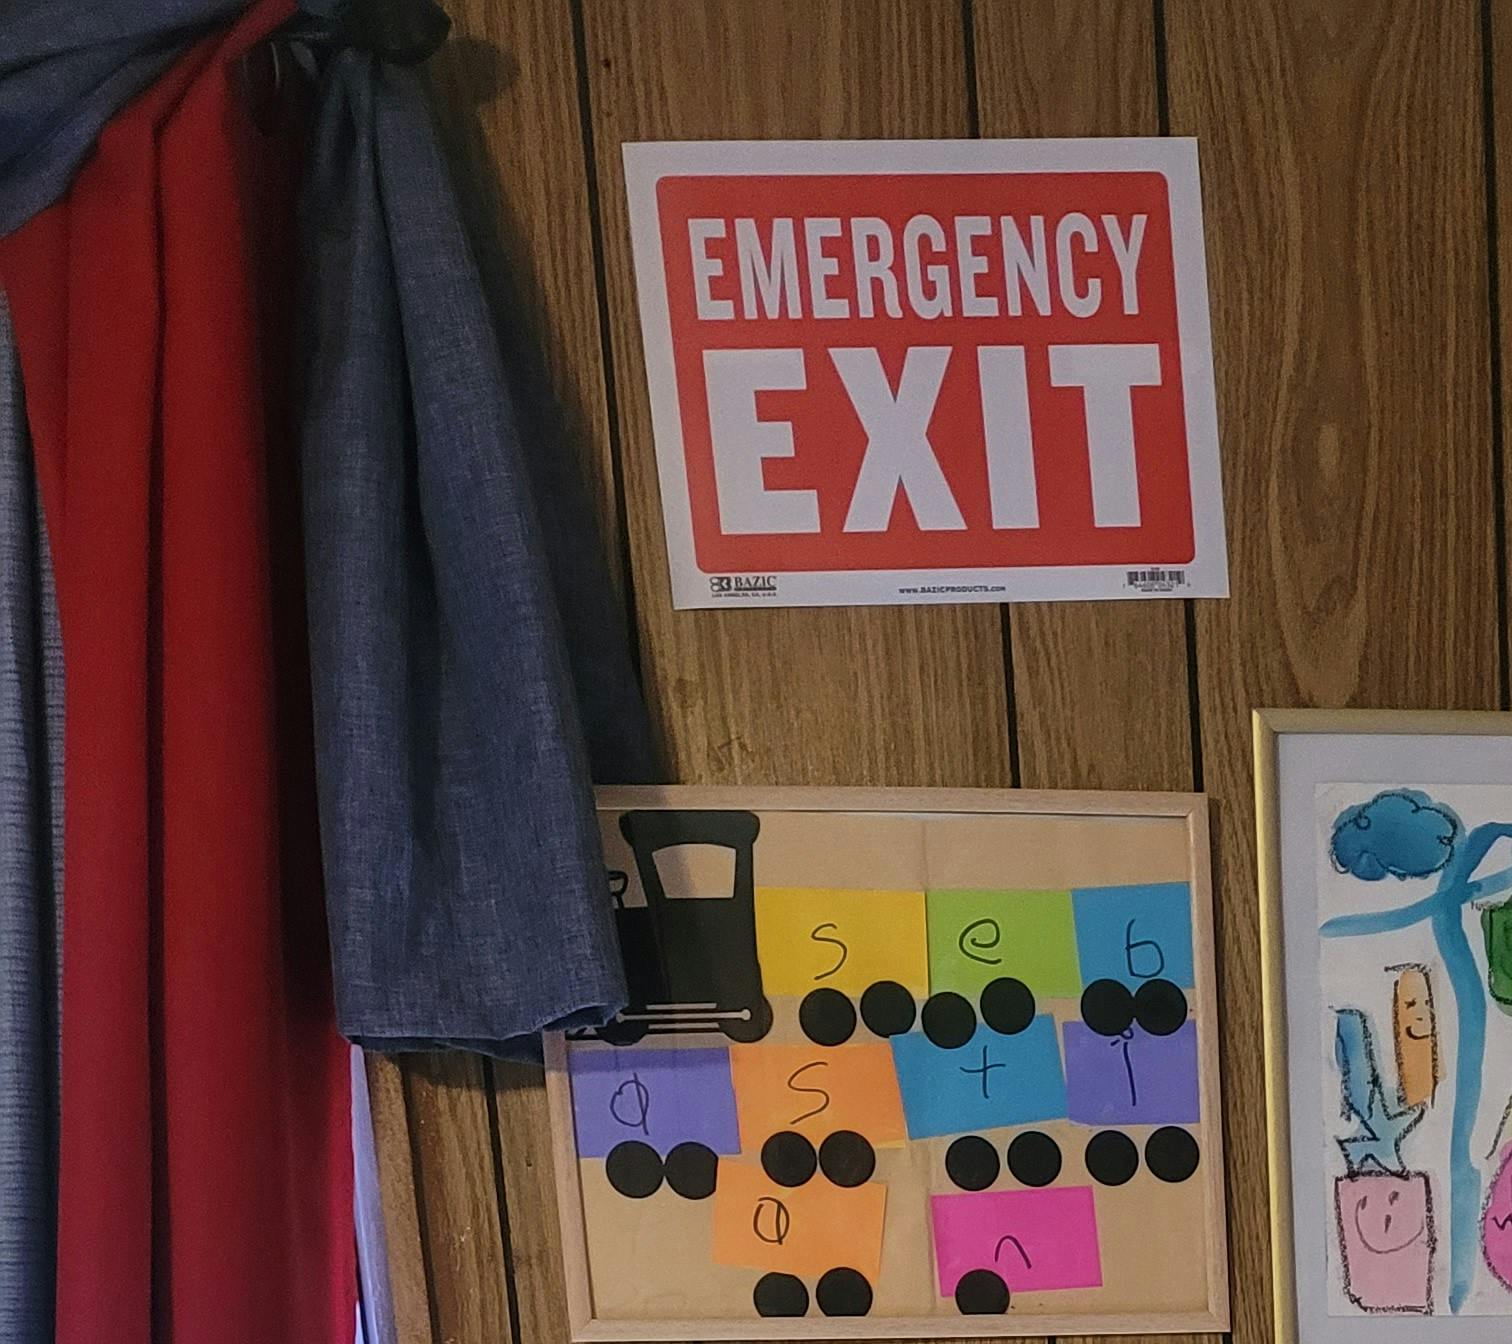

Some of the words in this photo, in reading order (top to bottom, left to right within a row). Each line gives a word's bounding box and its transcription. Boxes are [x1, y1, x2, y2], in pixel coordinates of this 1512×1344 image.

[687, 212, 1148, 321] EMERGENCY
[702, 343, 1162, 535] EXIT
[734, 575, 777, 588] BAZIC
[959, 918, 1002, 964] e
